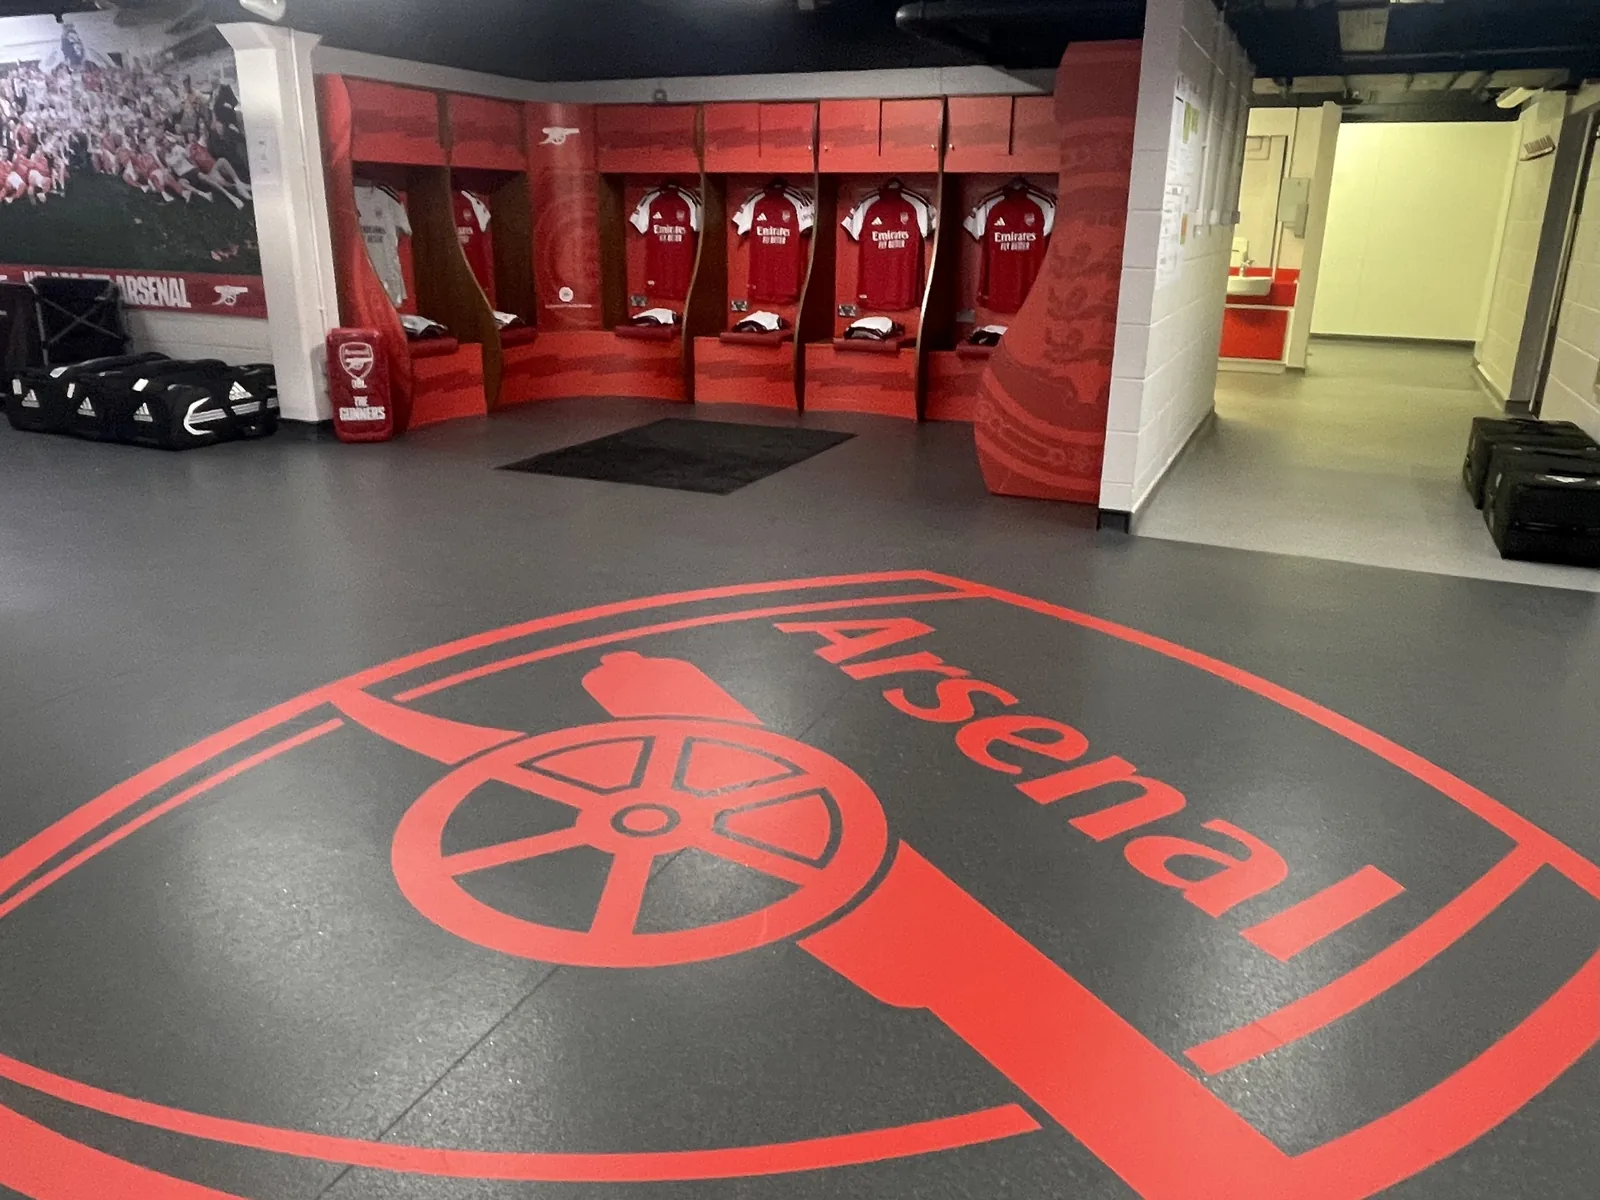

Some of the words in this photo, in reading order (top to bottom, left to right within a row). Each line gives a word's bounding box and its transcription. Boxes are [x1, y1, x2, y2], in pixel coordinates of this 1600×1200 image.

[756, 225, 791, 237] Emirates
[871, 229, 909, 241] Emirates
[994, 231, 1037, 243] Emirates
[116, 275, 191, 309] ARSENAL
[774, 617, 1406, 963] Arsenal
